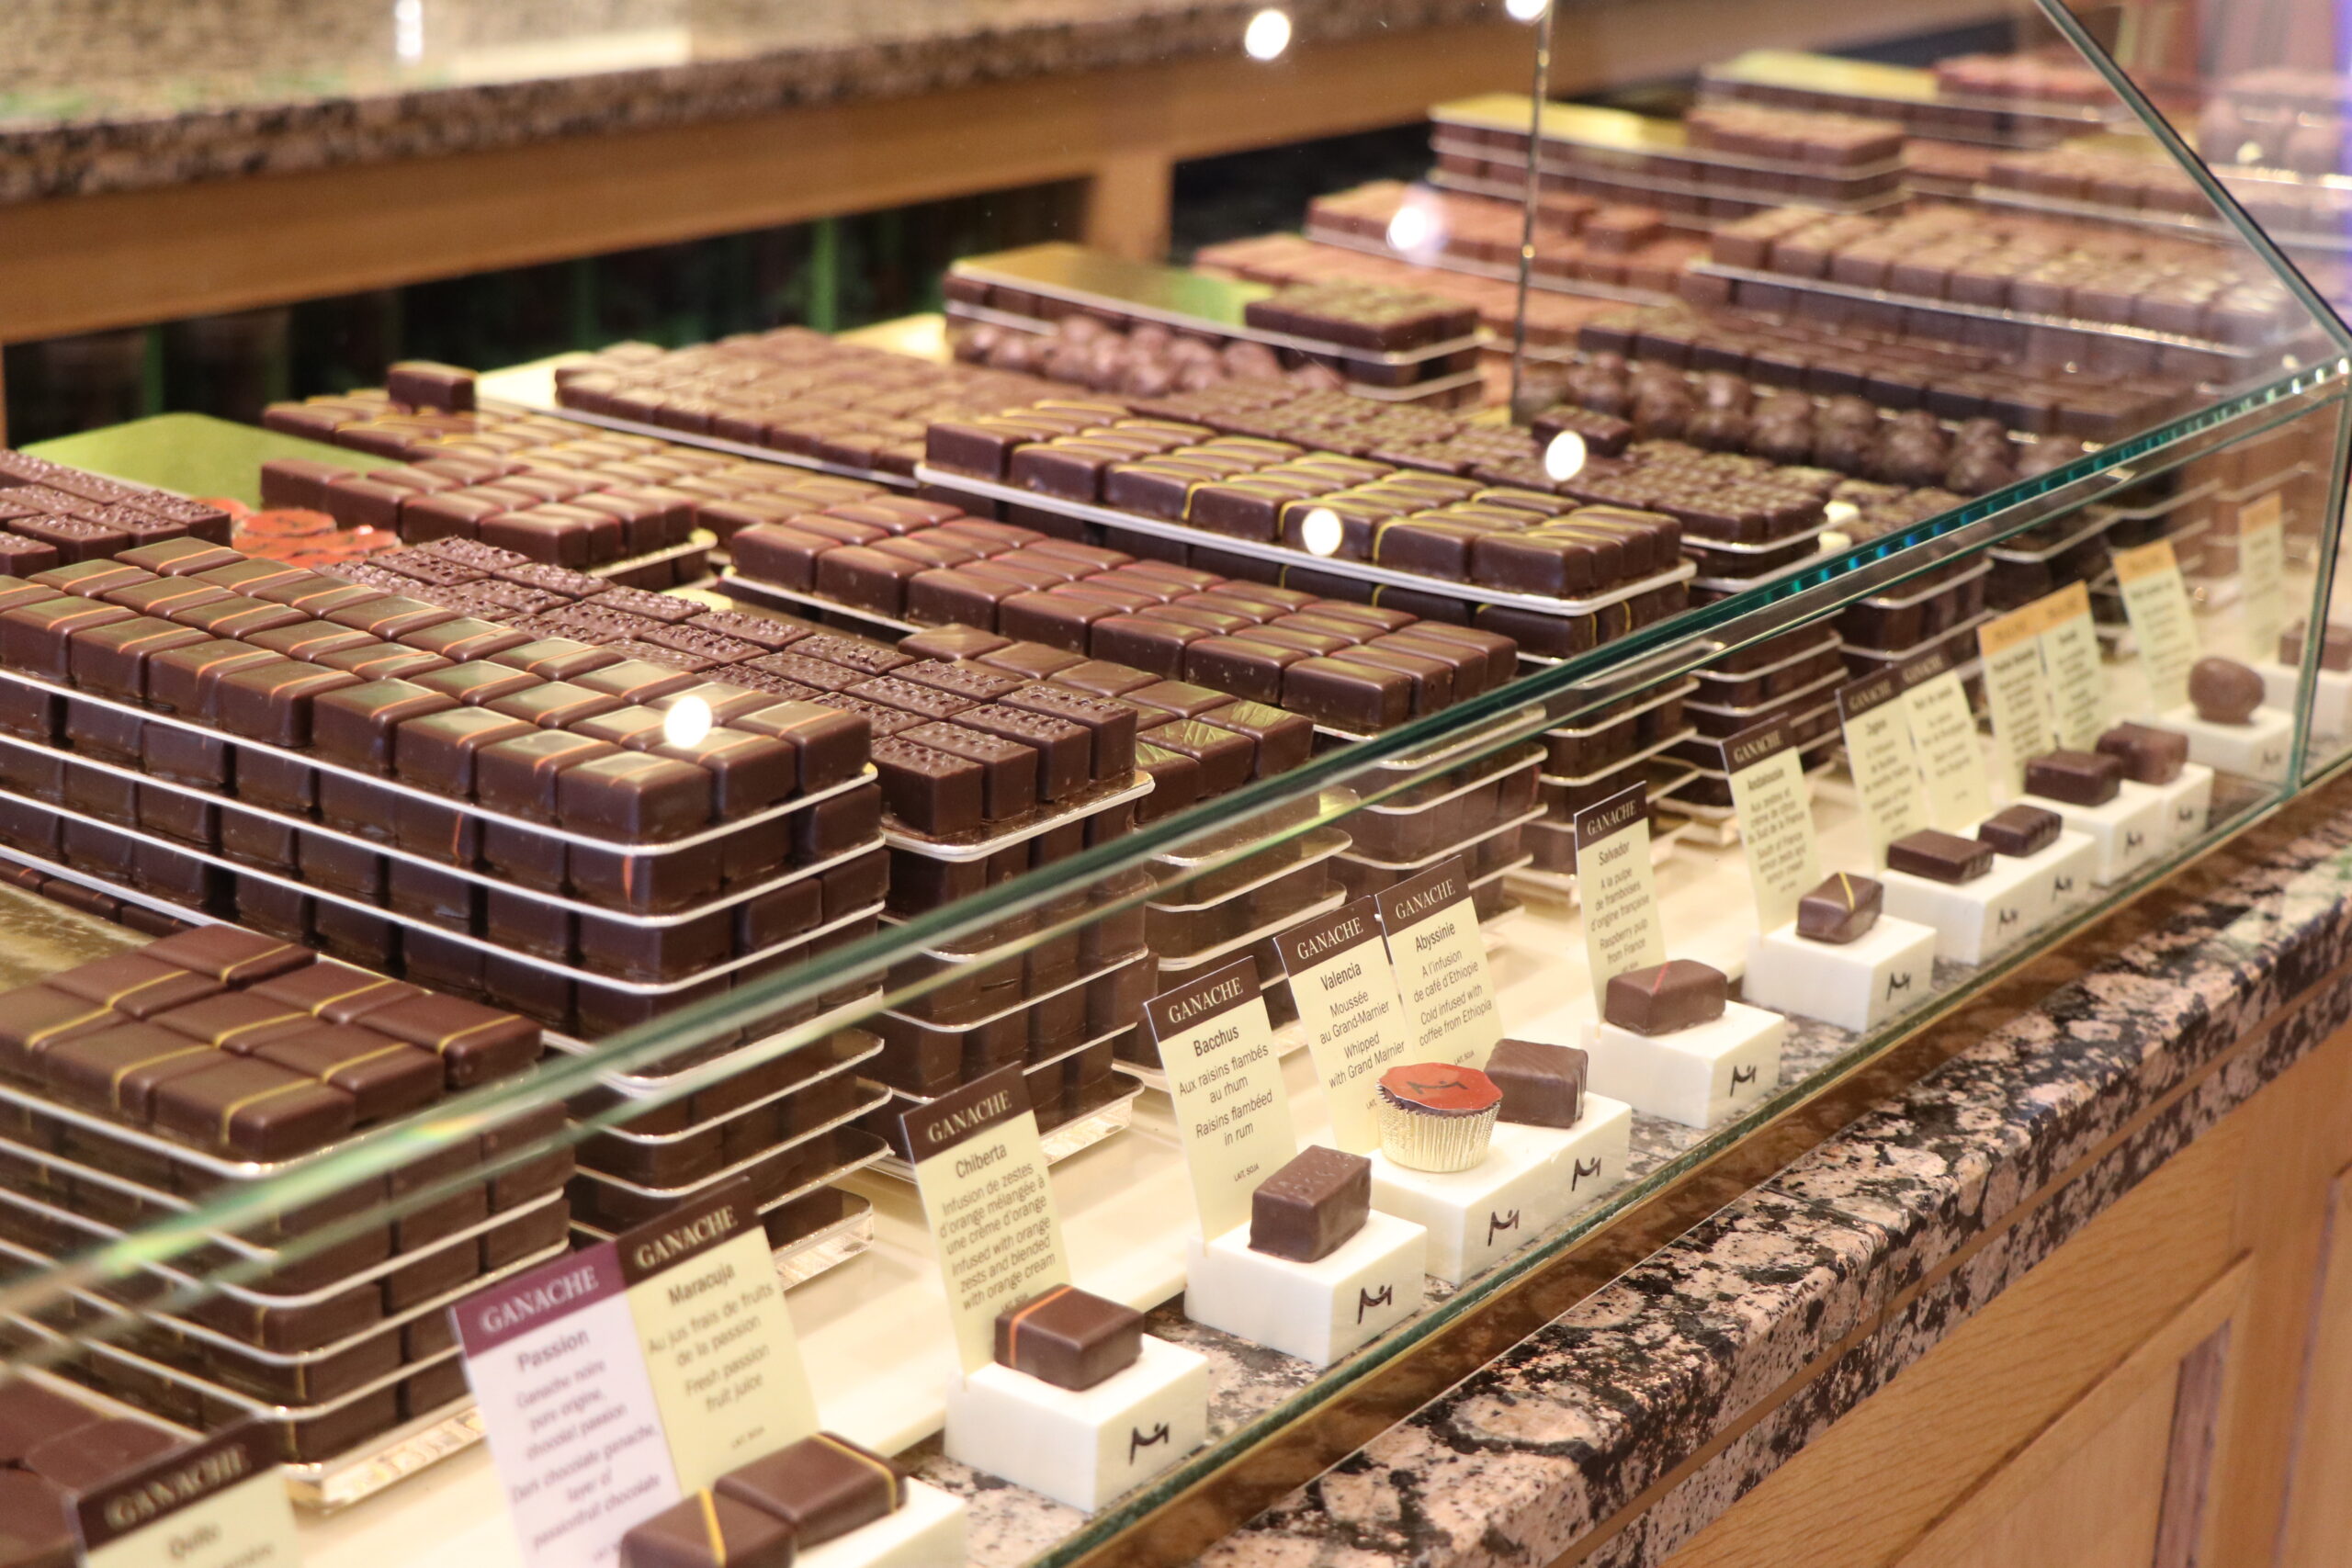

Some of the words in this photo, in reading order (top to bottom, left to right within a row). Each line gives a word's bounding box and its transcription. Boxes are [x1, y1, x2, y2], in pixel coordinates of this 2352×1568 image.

[1734, 729, 1782, 763] GANACHE
[1587, 800, 1636, 836] GANACHE
[1599, 840, 1630, 865] Salvador
[1595, 898, 1603, 911] de
[1605, 881, 1641, 907] framboises
[1614, 868, 1632, 886] pulpe
[1396, 878, 1455, 919] GANACHE
[1297, 917, 1364, 960] GANACHE
[1415, 922, 1455, 953] Abyssinie
[1600, 928, 1633, 951] Raspberry
[1634, 918, 1648, 934] pulp
[1607, 949, 1623, 964] from
[1624, 938, 1646, 955] France
[1320, 962, 1362, 992] Valencia
[1414, 989, 1424, 1003] de
[1425, 978, 1442, 998] café
[1169, 977, 1243, 1023] GANACHE
[1329, 991, 1369, 1018] Moussée
[1420, 1008, 1438, 1025] Cold
[1440, 991, 1466, 1015] infused
[1467, 984, 1483, 999] with
[1193, 1025, 1239, 1057] Bacchus
[1319, 1032, 1331, 1044] au
[1332, 1001, 1389, 1037] Grand-Marnier
[1419, 1026, 1443, 1047] coffee
[1445, 1017, 1462, 1034] from
[1463, 998, 1492, 1023] Ethiopia
[1329, 1069, 1346, 1089] with
[1348, 1055, 1373, 1079] Grand
[1374, 1041, 1406, 1065] Marnier
[1344, 1032, 1380, 1059] Whipped
[1180, 1080, 1195, 1096] Aux
[1198, 1061, 1230, 1087] raisins
[1231, 1043, 1269, 1070] flambés
[1209, 1089, 1221, 1102] au
[1224, 1075, 1248, 1093] rhum
[928, 1089, 1012, 1143] GANACHE
[1196, 1112, 1230, 1139] Raisins
[1232, 1089, 1272, 1121] flambéed
[1224, 1131, 1233, 1146] in
[1236, 1122, 1253, 1138] rum
[956, 1143, 1007, 1179] Chiberta
[943, 1186, 984, 1216] Infusion
[987, 1179, 1000, 1194] de
[1002, 1162, 1034, 1188] zestes
[988, 1185, 1035, 1215] mélangée
[1037, 1174, 1046, 1189] à
[634, 1205, 738, 1269] GANACHE
[947, 1238, 967, 1255] une
[969, 1220, 1001, 1244] crème
[952, 1247, 991, 1277] Infused
[993, 1235, 1014, 1254] with
[1016, 1216, 1051, 1243] orange
[668, 1261, 735, 1306] Maracuja
[960, 1270, 987, 1293] zests
[989, 1260, 1009, 1277] and
[1011, 1236, 1051, 1265] blended
[963, 1291, 985, 1311] with
[988, 1274, 1023, 1298] orange
[1024, 1253, 1056, 1279] cream
[481, 1264, 599, 1332] GANACHE
[649, 1334, 665, 1354] Au
[670, 1326, 688, 1351] jus
[691, 1311, 718, 1333] frais
[722, 1300, 739, 1317] de
[741, 1284, 775, 1306] fruits
[518, 1330, 590, 1372] Passion
[677, 1349, 693, 1367] de
[697, 1340, 710, 1356] la
[712, 1314, 762, 1351] passion
[685, 1367, 721, 1396] Fresh
[723, 1343, 770, 1378] passion
[706, 1389, 732, 1414] fruit
[735, 1374, 763, 1402] juice
[104, 1443, 251, 1530] GANACHE
